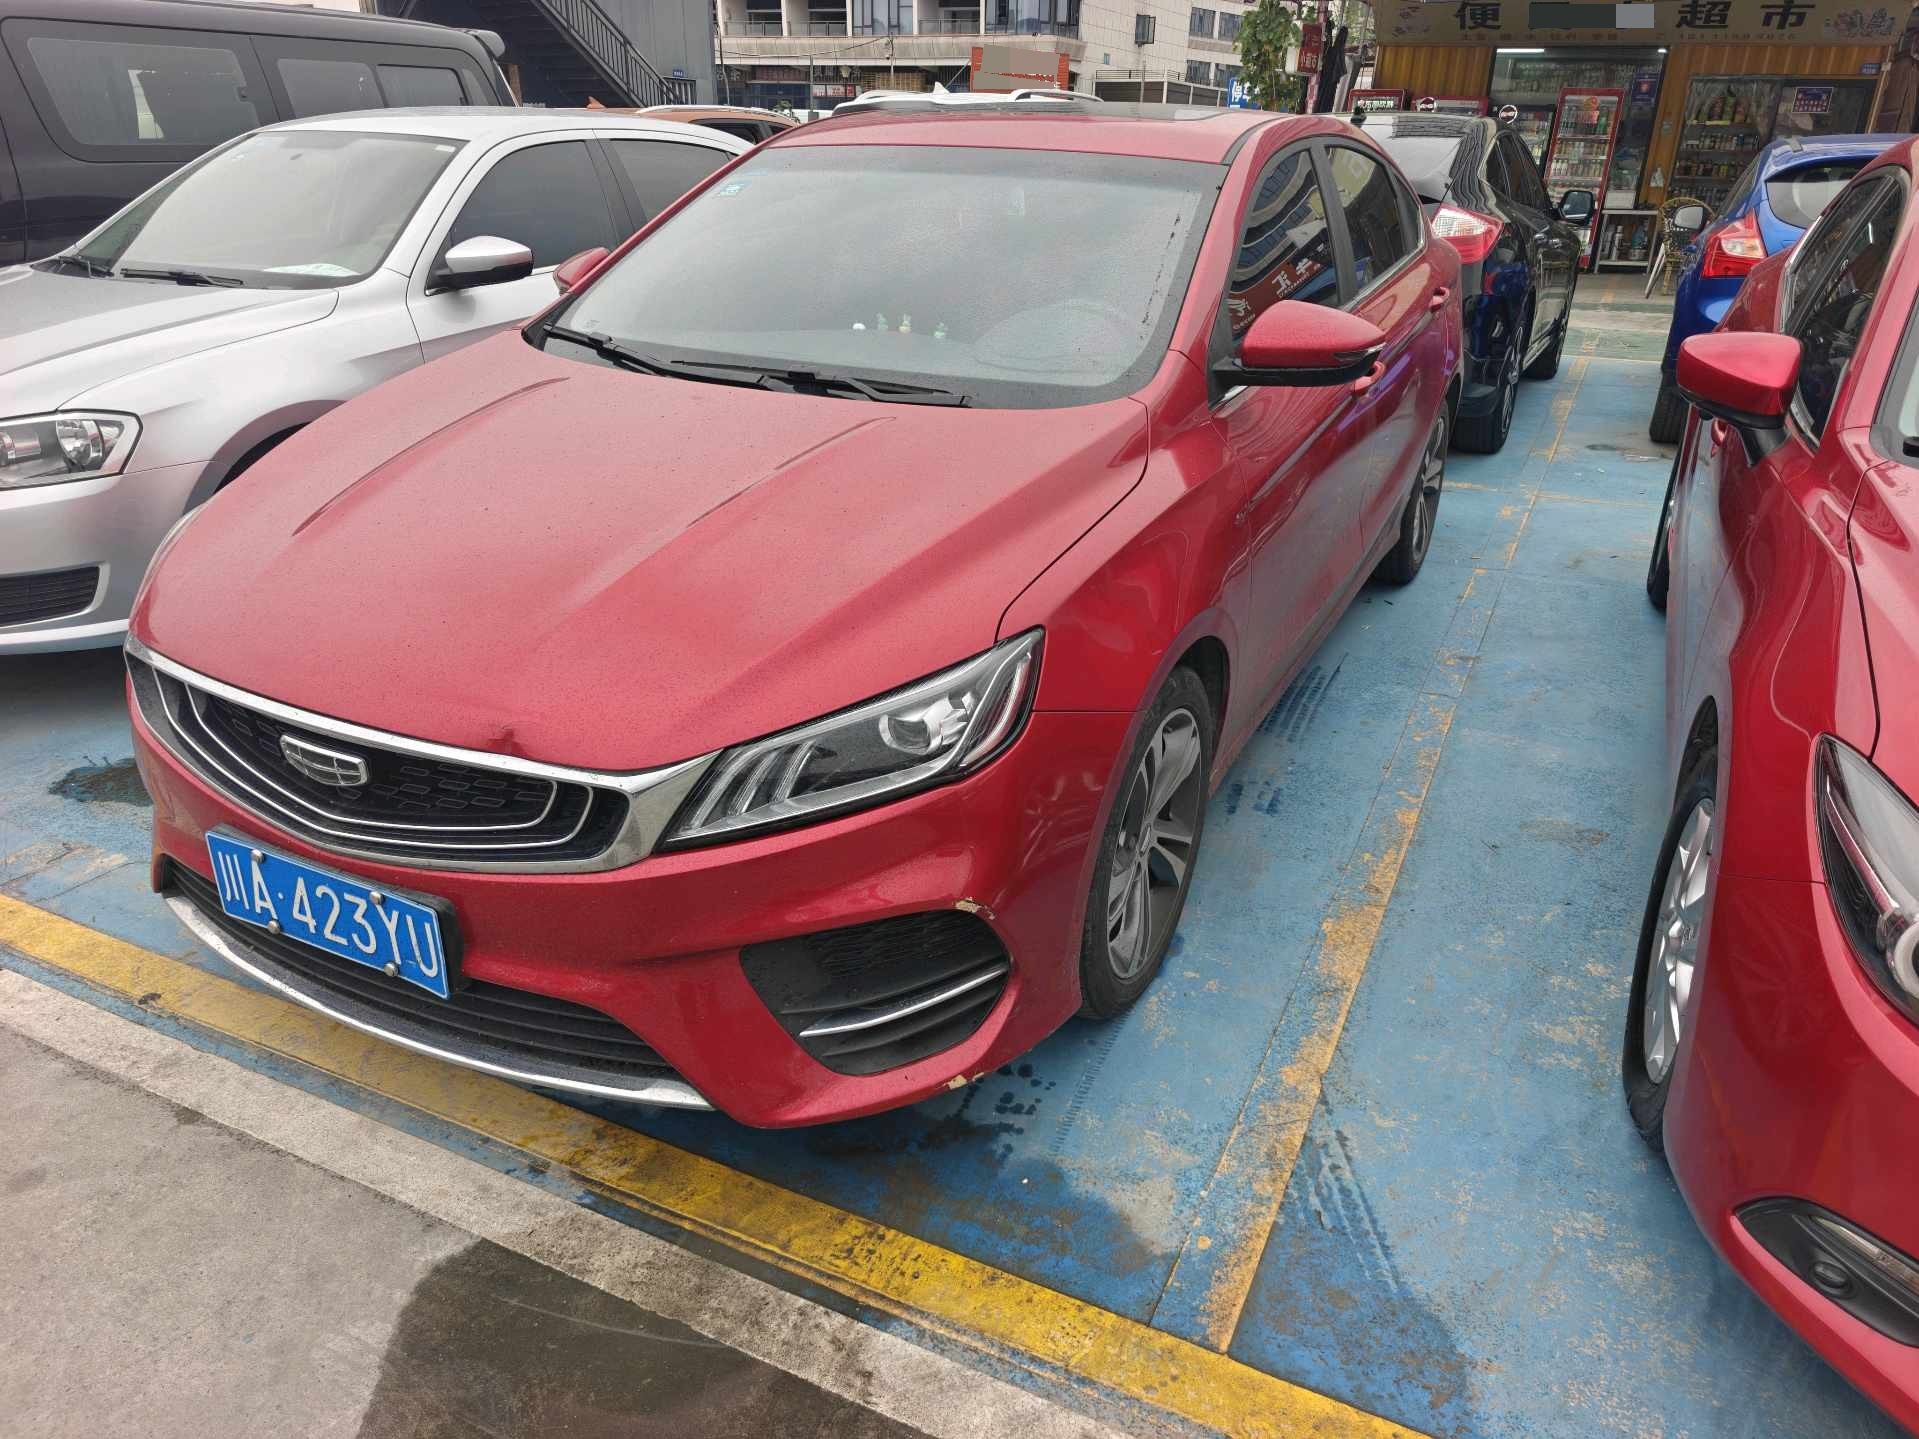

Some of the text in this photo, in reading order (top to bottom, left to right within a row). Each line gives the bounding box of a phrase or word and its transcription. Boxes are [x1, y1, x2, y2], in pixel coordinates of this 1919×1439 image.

[1455, 1, 1814, 30] 便 超市
[217, 851, 439, 978] 川A·423YU
